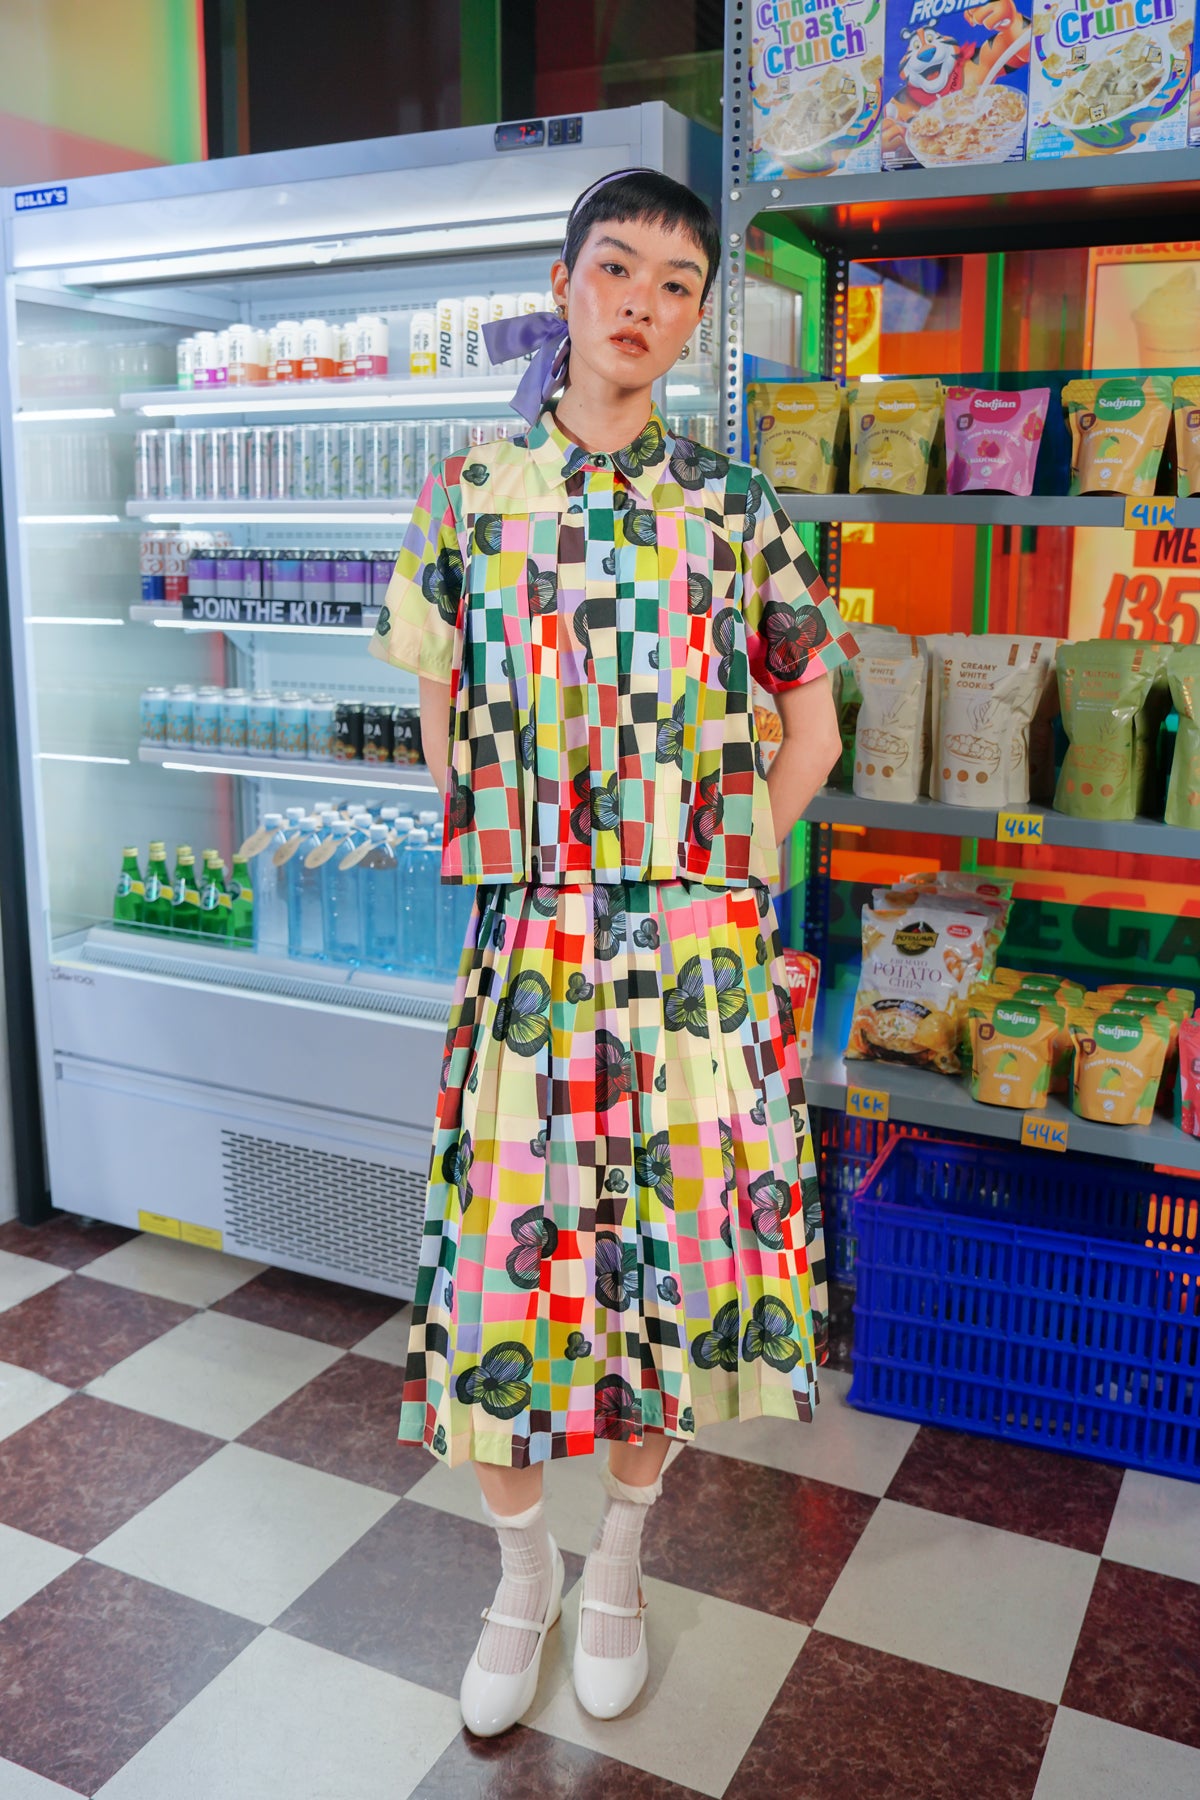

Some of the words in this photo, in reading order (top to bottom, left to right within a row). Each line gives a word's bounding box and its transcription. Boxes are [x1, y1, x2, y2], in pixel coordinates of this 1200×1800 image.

[778, 6, 845, 46] Toast
[767, 23, 865, 74] Crunch
[16, 189, 66, 208] BILLY'S
[974, 398, 1016, 411] Sadjian
[1131, 504, 1175, 526] 41K
[192, 597, 241, 620] JOIN
[242, 599, 284, 623] THE
[289, 601, 350, 626] KULT
[959, 671, 988, 680] WHITE
[961, 661, 998, 671] CREAMY
[1004, 818, 1041, 837] 46K
[873, 962, 943, 984] POTATO
[888, 978, 922, 990] CHIPS
